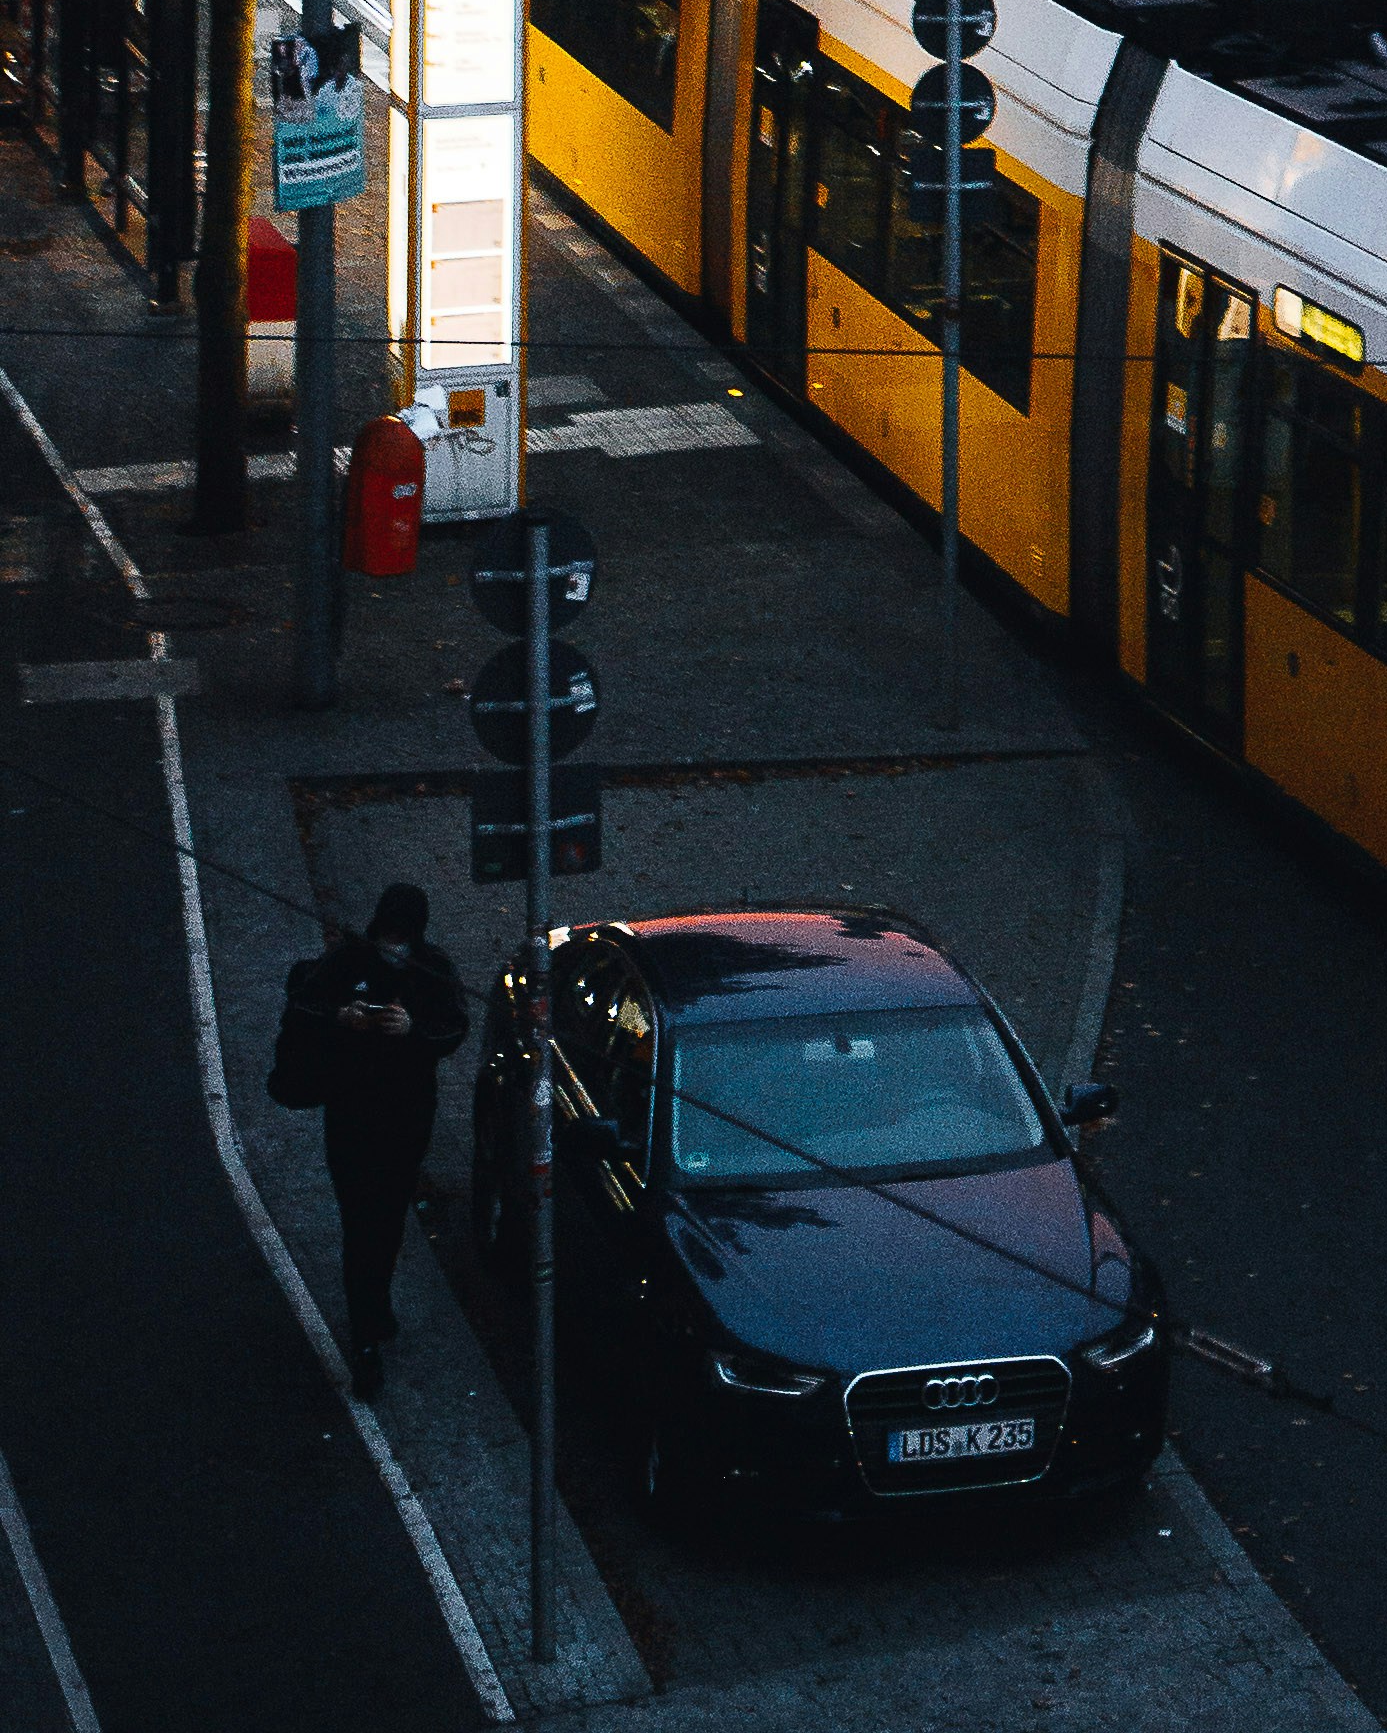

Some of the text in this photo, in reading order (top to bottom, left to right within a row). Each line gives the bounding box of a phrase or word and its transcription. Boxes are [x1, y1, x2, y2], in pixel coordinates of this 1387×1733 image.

[903, 1421, 1032, 1458] LDS K 235
